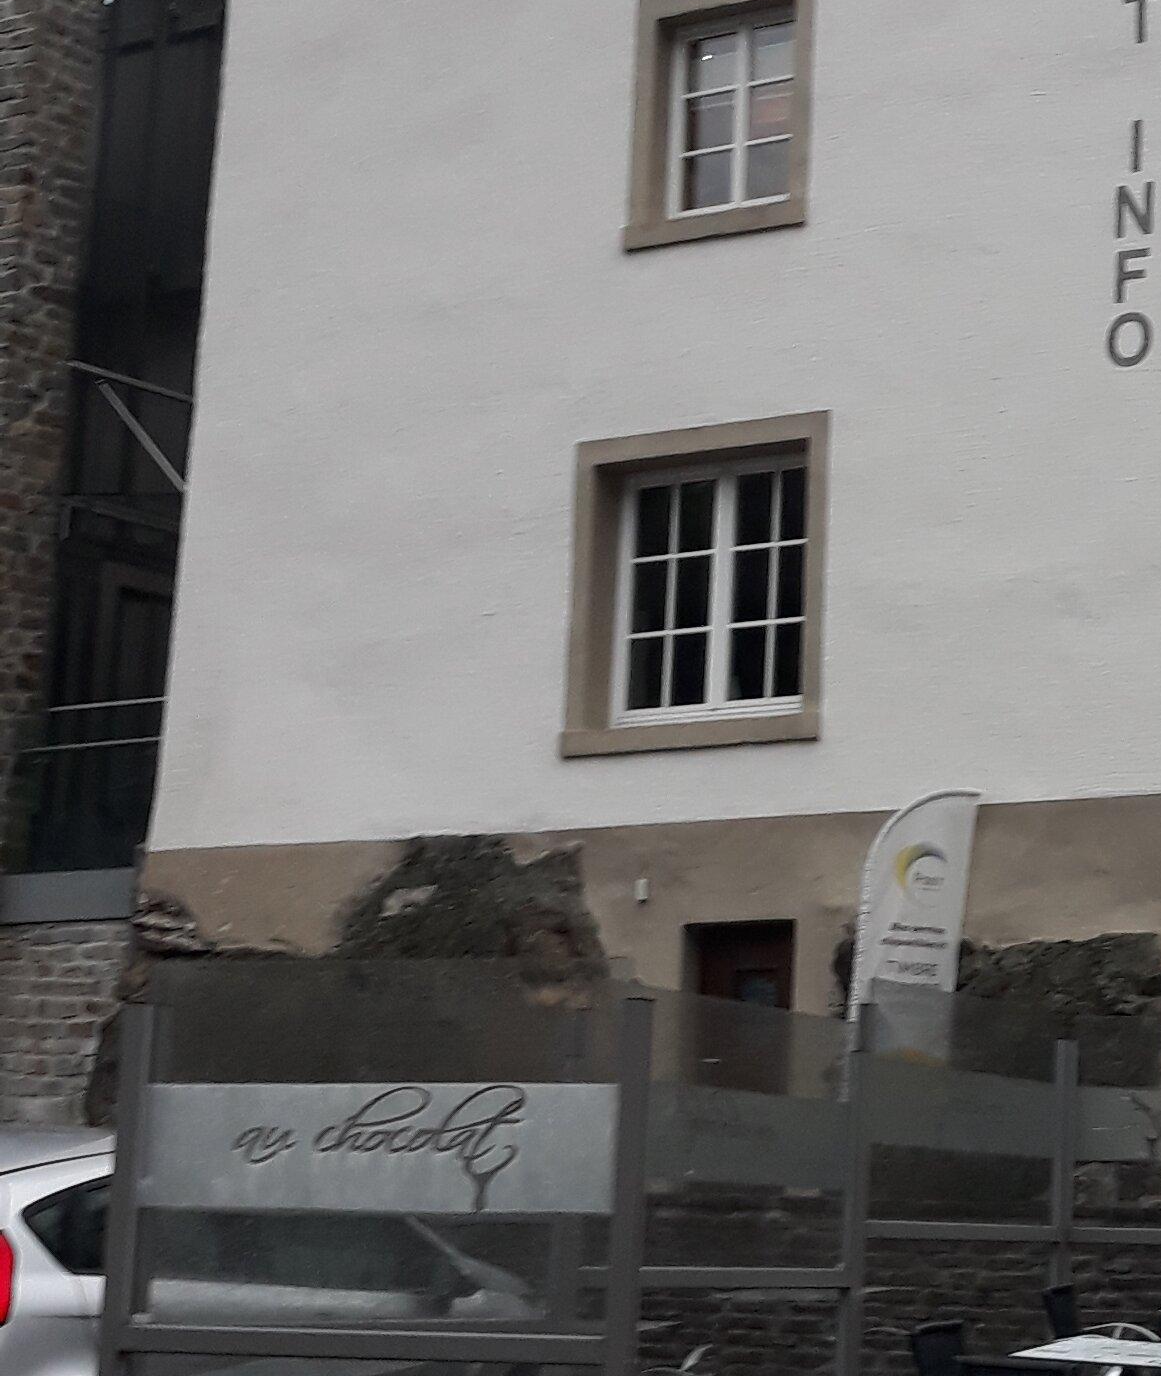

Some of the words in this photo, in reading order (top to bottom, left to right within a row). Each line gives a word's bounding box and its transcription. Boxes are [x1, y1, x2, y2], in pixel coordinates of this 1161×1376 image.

[1104, 118, 1156, 369] INFO
[231, 1124, 297, 1164] au
[313, 1084, 526, 1165] chocolat
